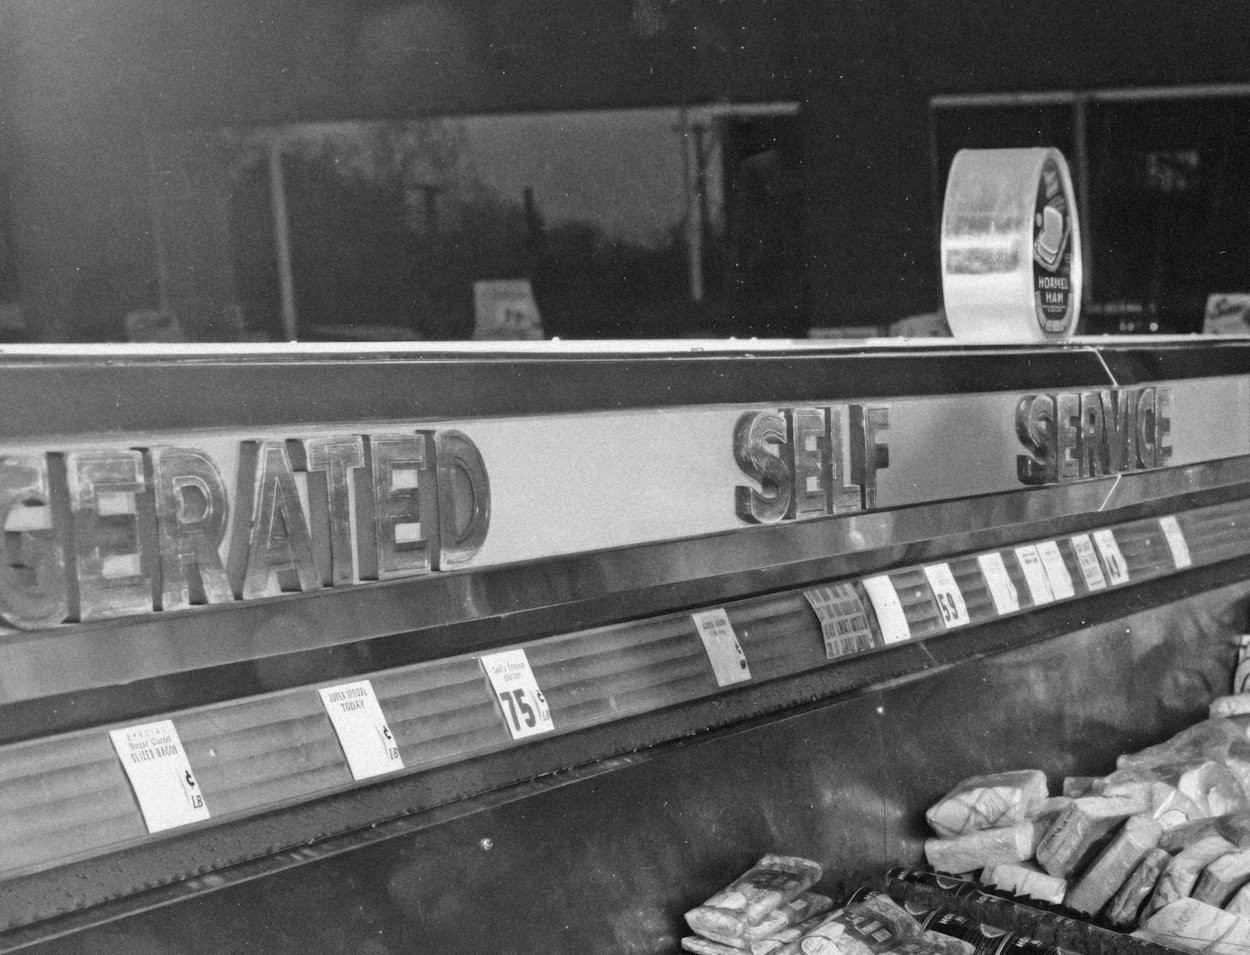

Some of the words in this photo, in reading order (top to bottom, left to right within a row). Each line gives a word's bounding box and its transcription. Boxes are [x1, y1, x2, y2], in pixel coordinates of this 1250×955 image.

[733, 404, 891, 525] SELF
[1016, 384, 1174, 486] SERVICE
[340, 699, 366, 712] TODAY
[499, 688, 537, 732] 75
[191, 795, 204, 809] LB
